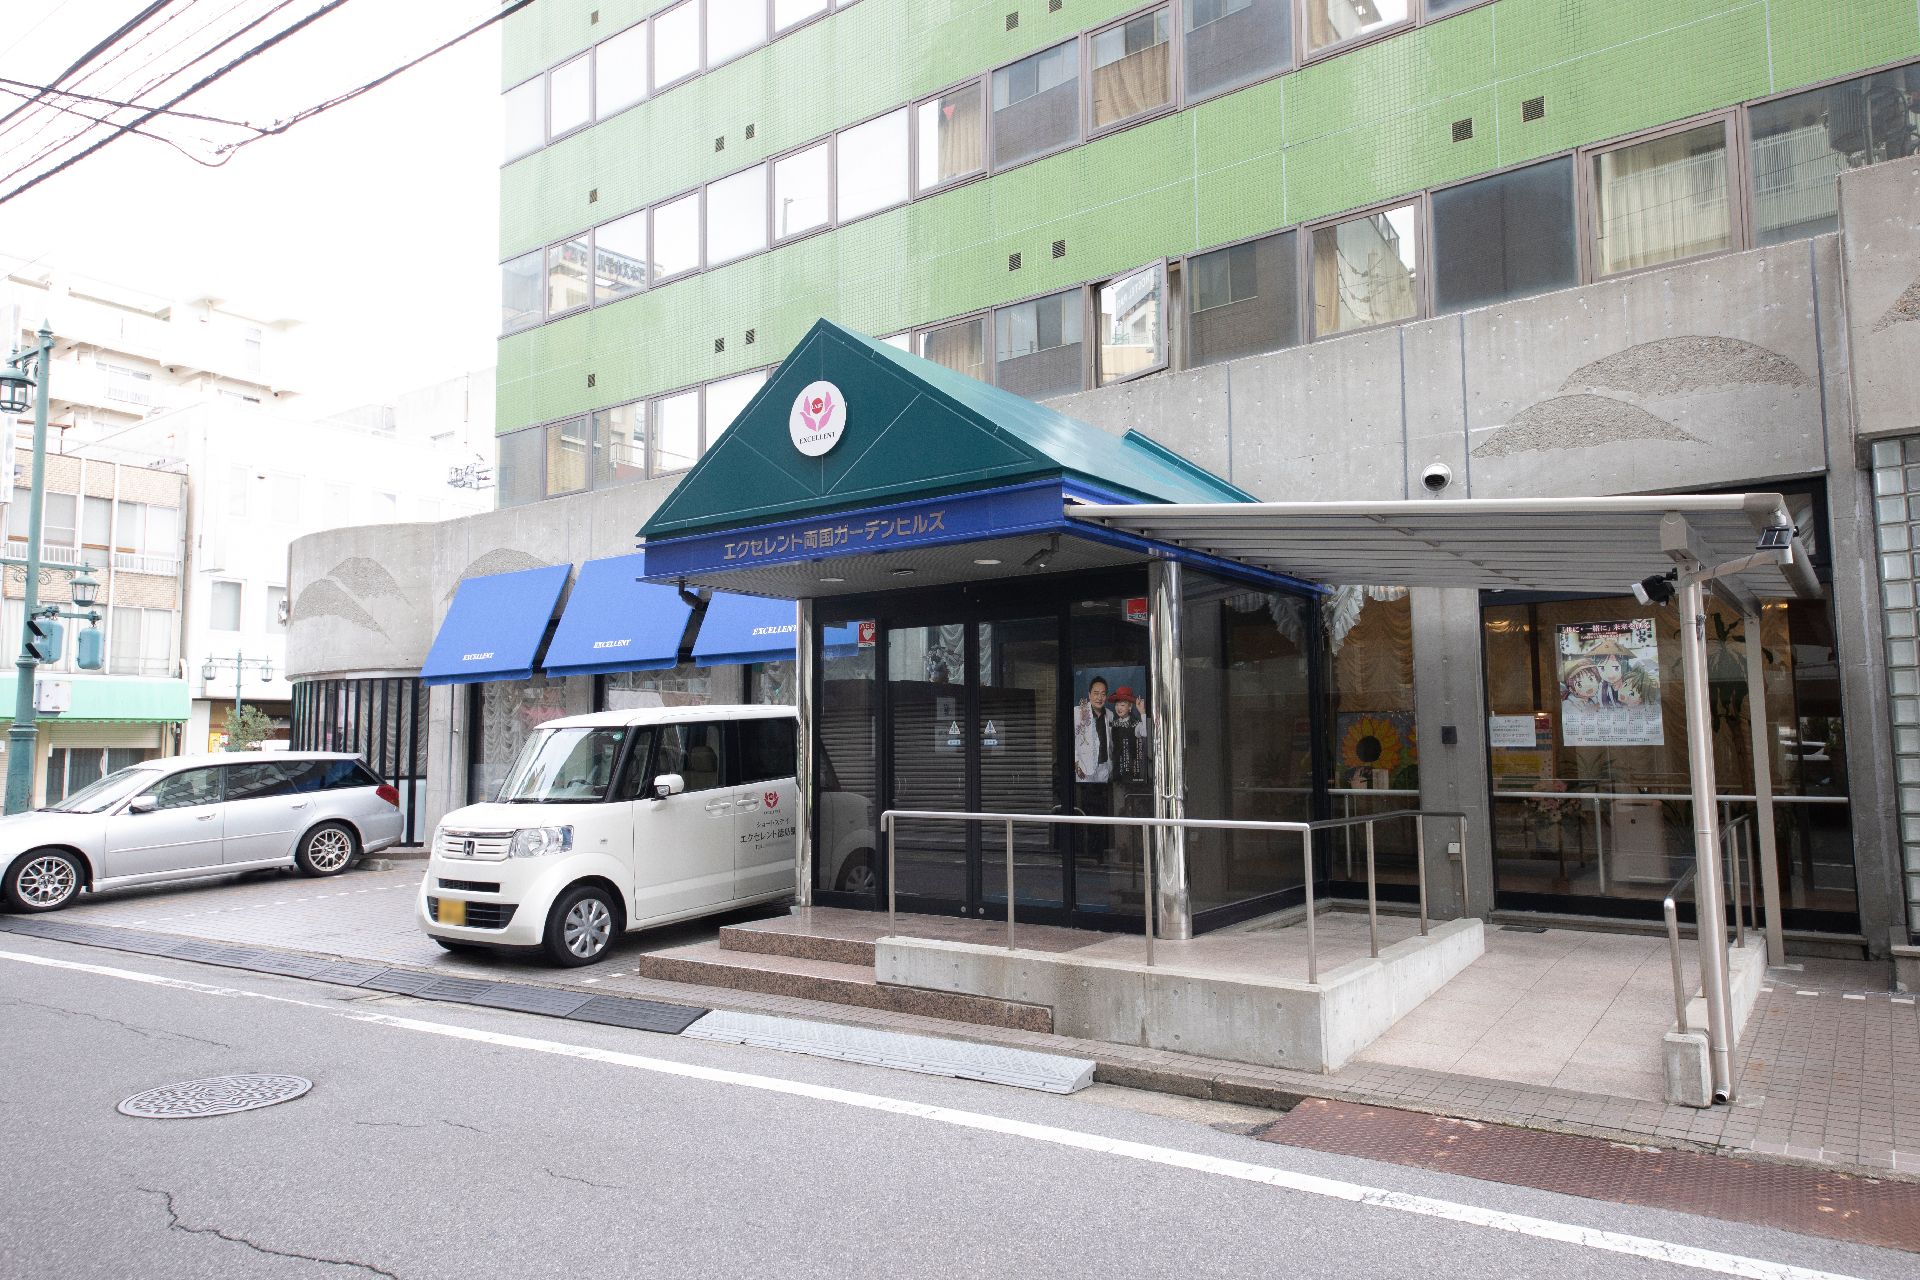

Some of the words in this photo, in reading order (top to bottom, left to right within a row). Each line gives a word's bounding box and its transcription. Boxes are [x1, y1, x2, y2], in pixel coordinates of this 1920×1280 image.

[799, 431, 836, 445] EXCELLENT
[723, 510, 946, 561] エクセレント両国ガーデンヒルズ
[592, 638, 632, 649] EXCELLENT
[462, 652, 495, 661] EXCELLENT
